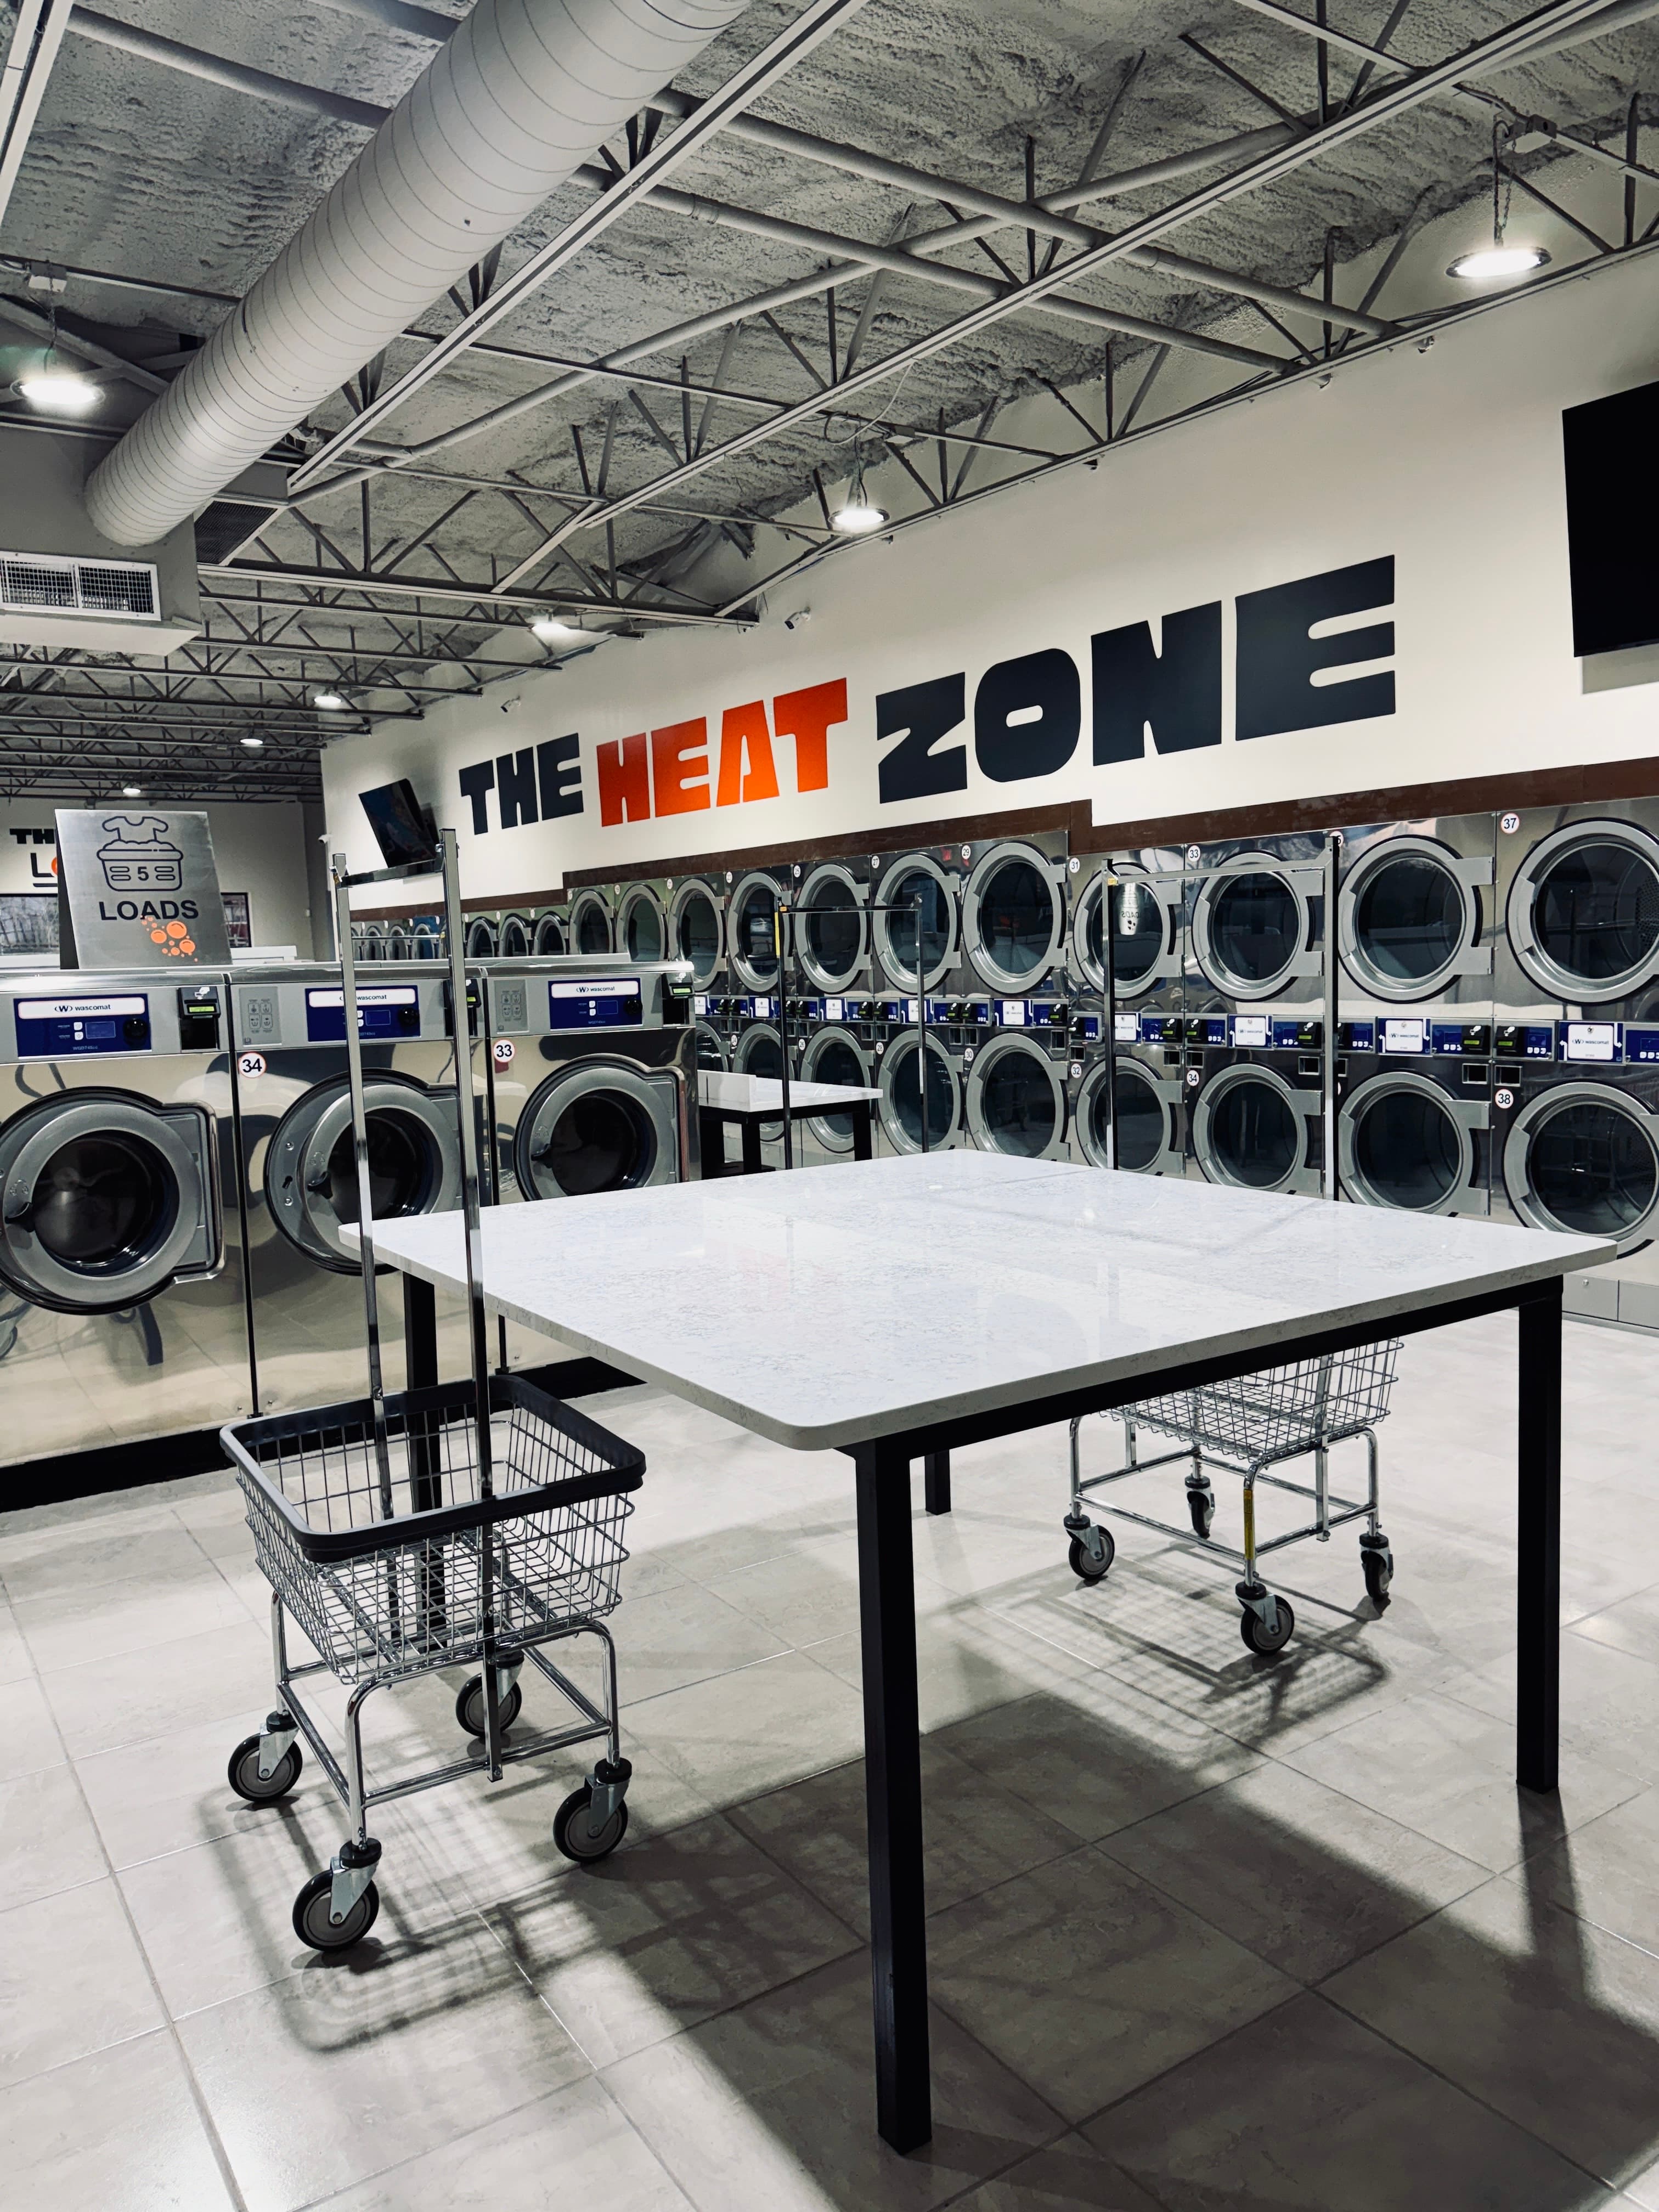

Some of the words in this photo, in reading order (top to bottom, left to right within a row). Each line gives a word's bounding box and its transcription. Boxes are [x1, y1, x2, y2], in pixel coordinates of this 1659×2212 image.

[459, 732, 584, 836] THE
[596, 678, 848, 827] HEAT
[876, 554, 1396, 804] ZONE
[1504, 817, 1517, 829] 37
[9, 828, 55, 844] TH
[1189, 849, 1199, 858] 33
[1071, 861, 1079, 870] 31
[137, 866, 149, 881] 5
[99, 900, 199, 921] LOADS
[496, 1044, 512, 1058] 33
[242, 1058, 262, 1073] 34
[1073, 1066, 1080, 1075] 32
[1188, 1073, 1197, 1082] 34
[1498, 1093, 1510, 1104] 38
